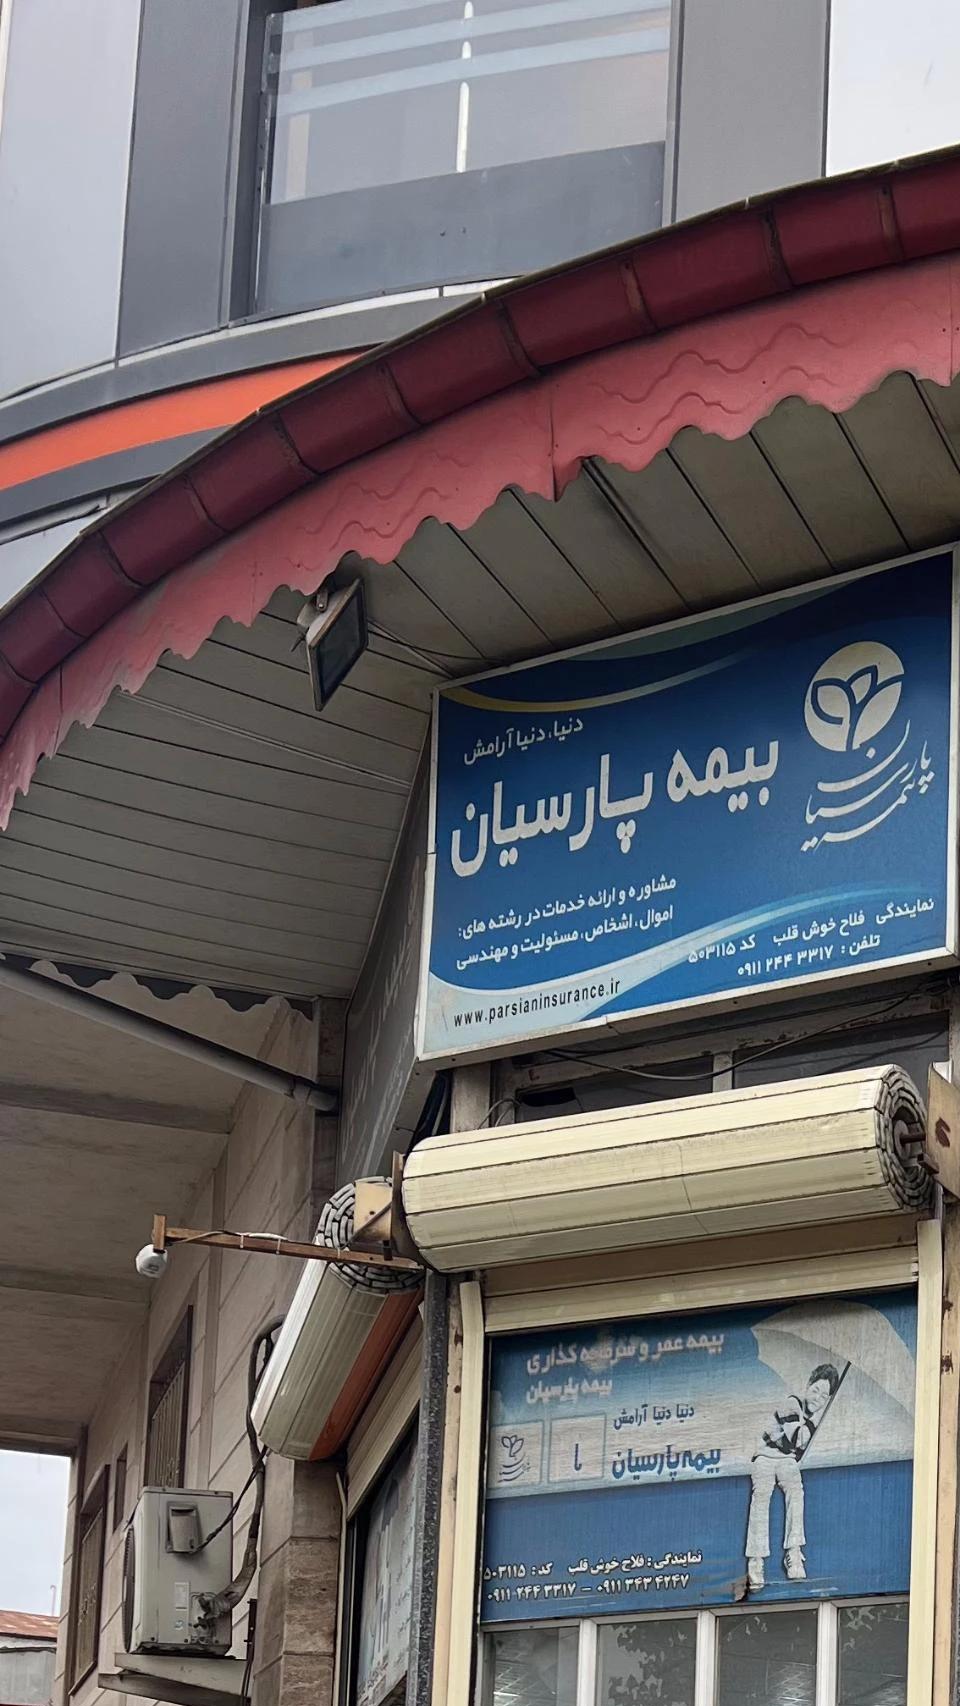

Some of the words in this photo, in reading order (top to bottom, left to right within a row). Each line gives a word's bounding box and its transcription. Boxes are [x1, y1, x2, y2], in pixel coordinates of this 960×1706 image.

[464, 728, 514, 765] آرامش
[516, 725, 546, 748] دنیا
[667, 740, 780, 813] بیمه
[451, 753, 654, 878] پارسیان
[542, 894, 585, 917] خدمات
[588, 888, 616, 909] ارائه
[618, 890, 626, 905] و
[488, 908, 522, 930] رشته
[525, 907, 541, 927] در
[839, 910, 865, 936] فلاح
[875, 898, 935, 926] نمایندگی
[773, 924, 798, 946] قلب
[802, 919, 836, 941] خوش
[511, 943, 519, 960] و
[520, 929, 579, 954] مسئولیت
[688, 942, 736, 963] ۵۰۳۱۱۵
[740, 934, 756, 952] کد
[456, 944, 508, 971] مهندسی
[738, 960, 761, 977] ۰۹۱۱
[766, 952, 792, 973] ۲۴۴
[797, 944, 834, 965] ۳۳۱۷
[453, 977, 621, 1028] www.parsianinsurance.ir
[651, 1337, 684, 1361] عمر
[686, 1333, 725, 1354] بیمه
[526, 1377, 580, 1404] پارسیان
[581, 1376, 613, 1398] بیمه
[613, 1403, 649, 1430] آرامش
[652, 1406, 671, 1426] دنیا
[676, 1402, 695, 1423] دنیا
[611, 1444, 681, 1481] پارسیان
[682, 1448, 722, 1474] بیمه
[568, 1558, 589, 1576] قلب
[590, 1557, 621, 1575] خوش
[621, 1554, 645, 1573] فلاح
